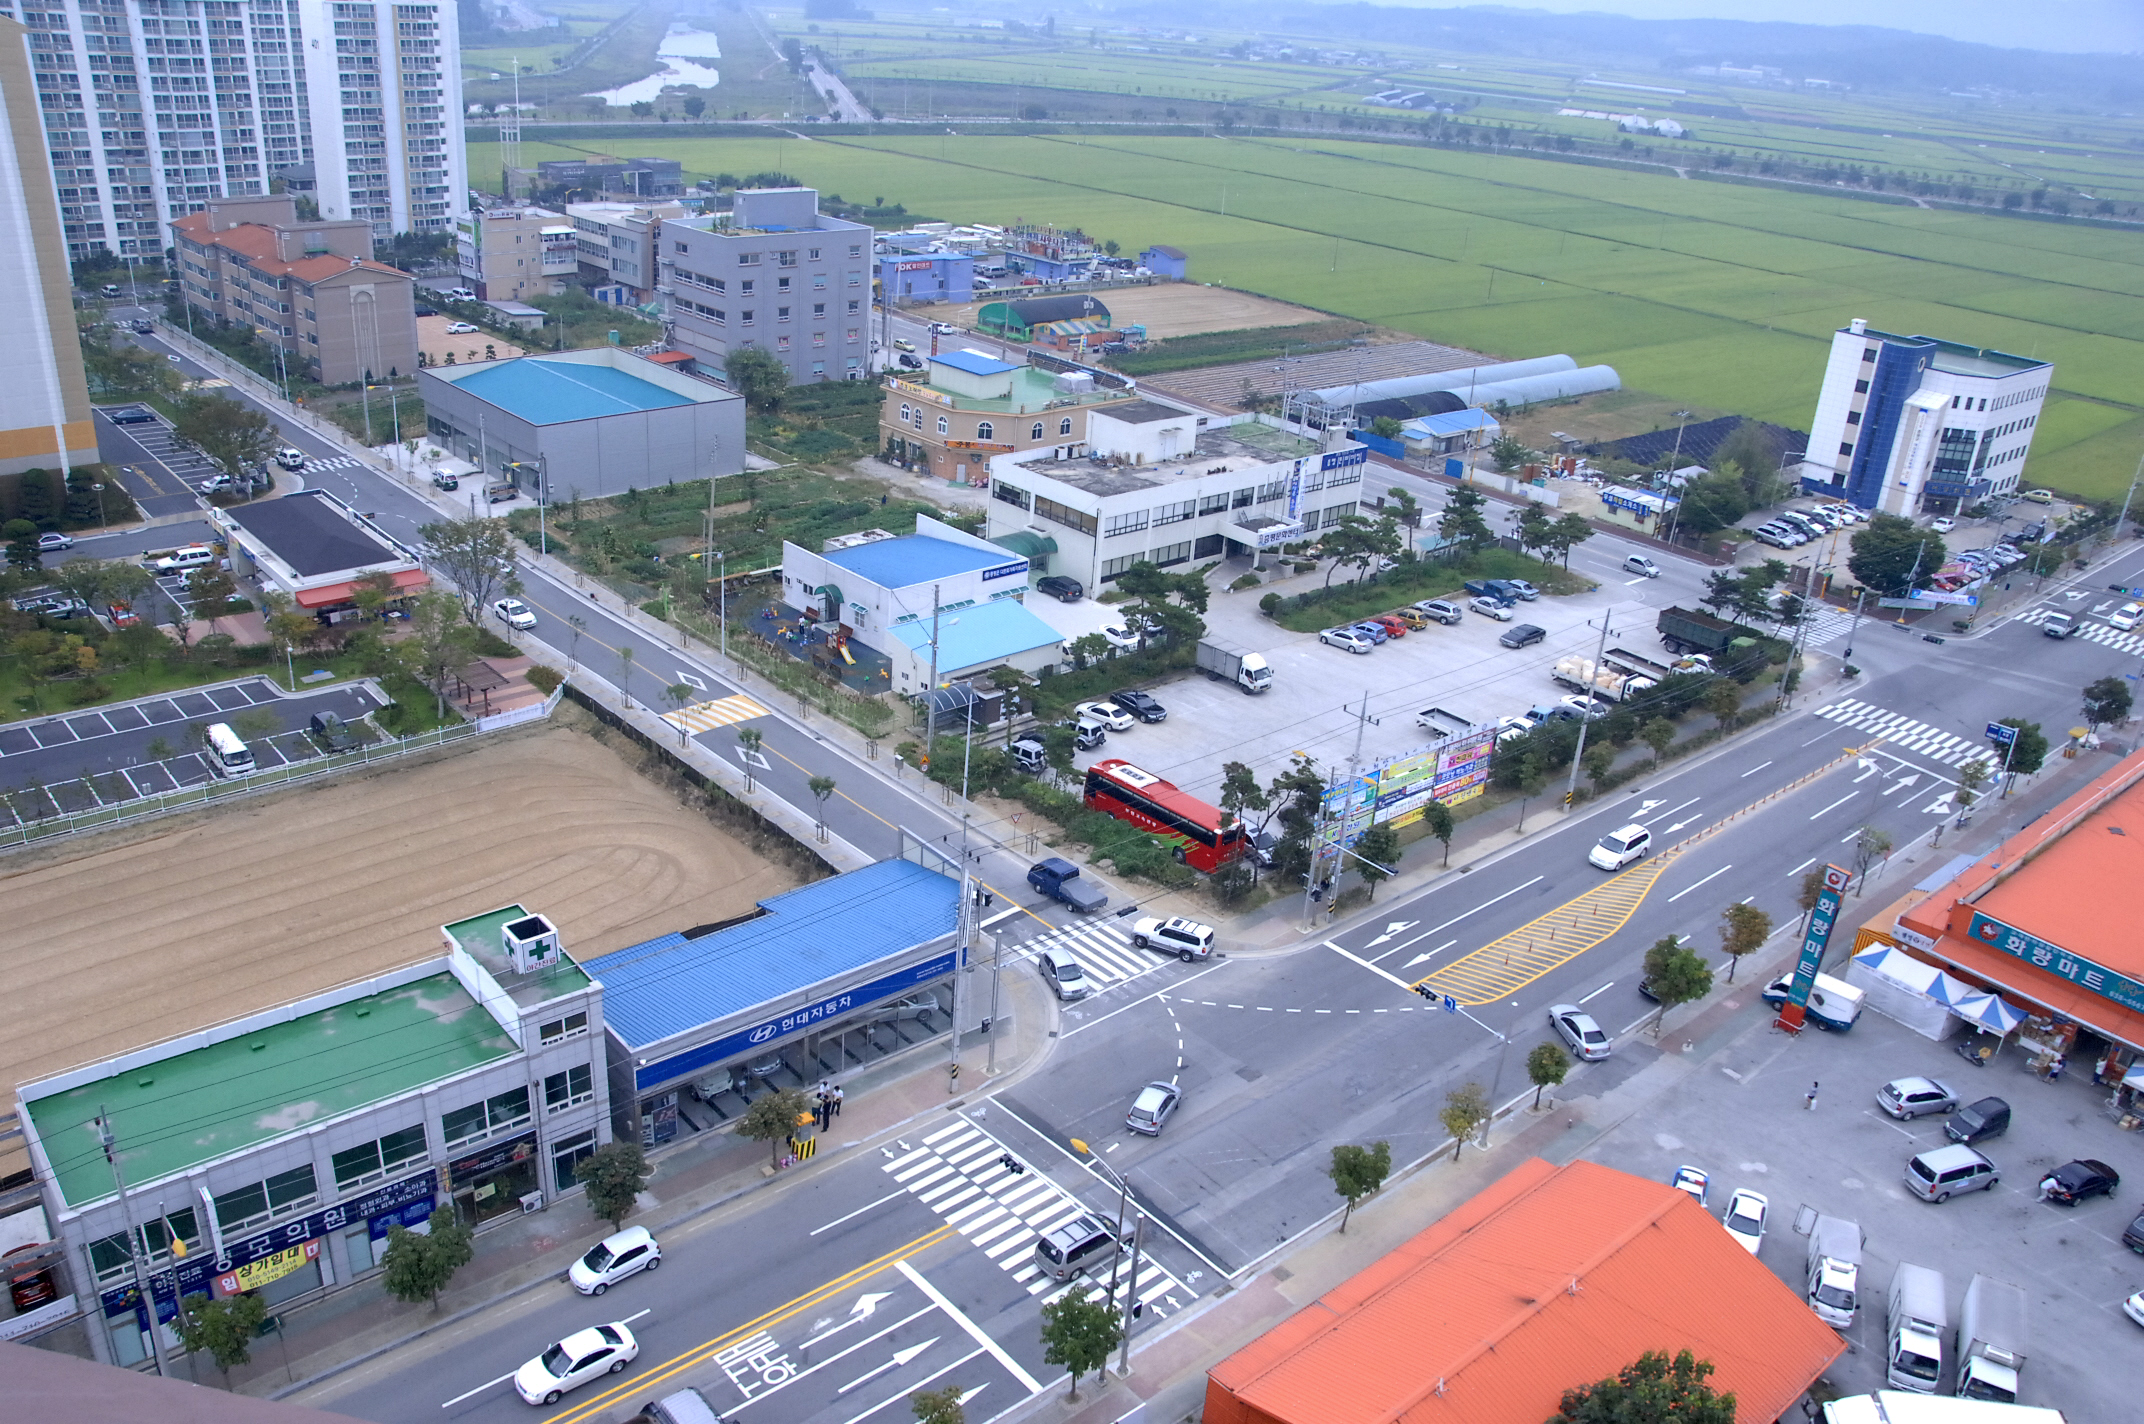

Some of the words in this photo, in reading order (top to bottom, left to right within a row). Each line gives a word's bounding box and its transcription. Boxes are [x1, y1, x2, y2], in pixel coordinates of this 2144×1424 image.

[1797, 897, 1836, 979] 화랑마트
[526, 957, 556, 972] 야간진료
[2004, 935, 2105, 991] 화랑마트
[781, 995, 852, 1032] 현대자동차
[359, 1194, 390, 1209] 정형외과
[404, 1180, 427, 1194] 소아과
[239, 1246, 301, 1279] 상가임대
[221, 1275, 237, 1292] 임
